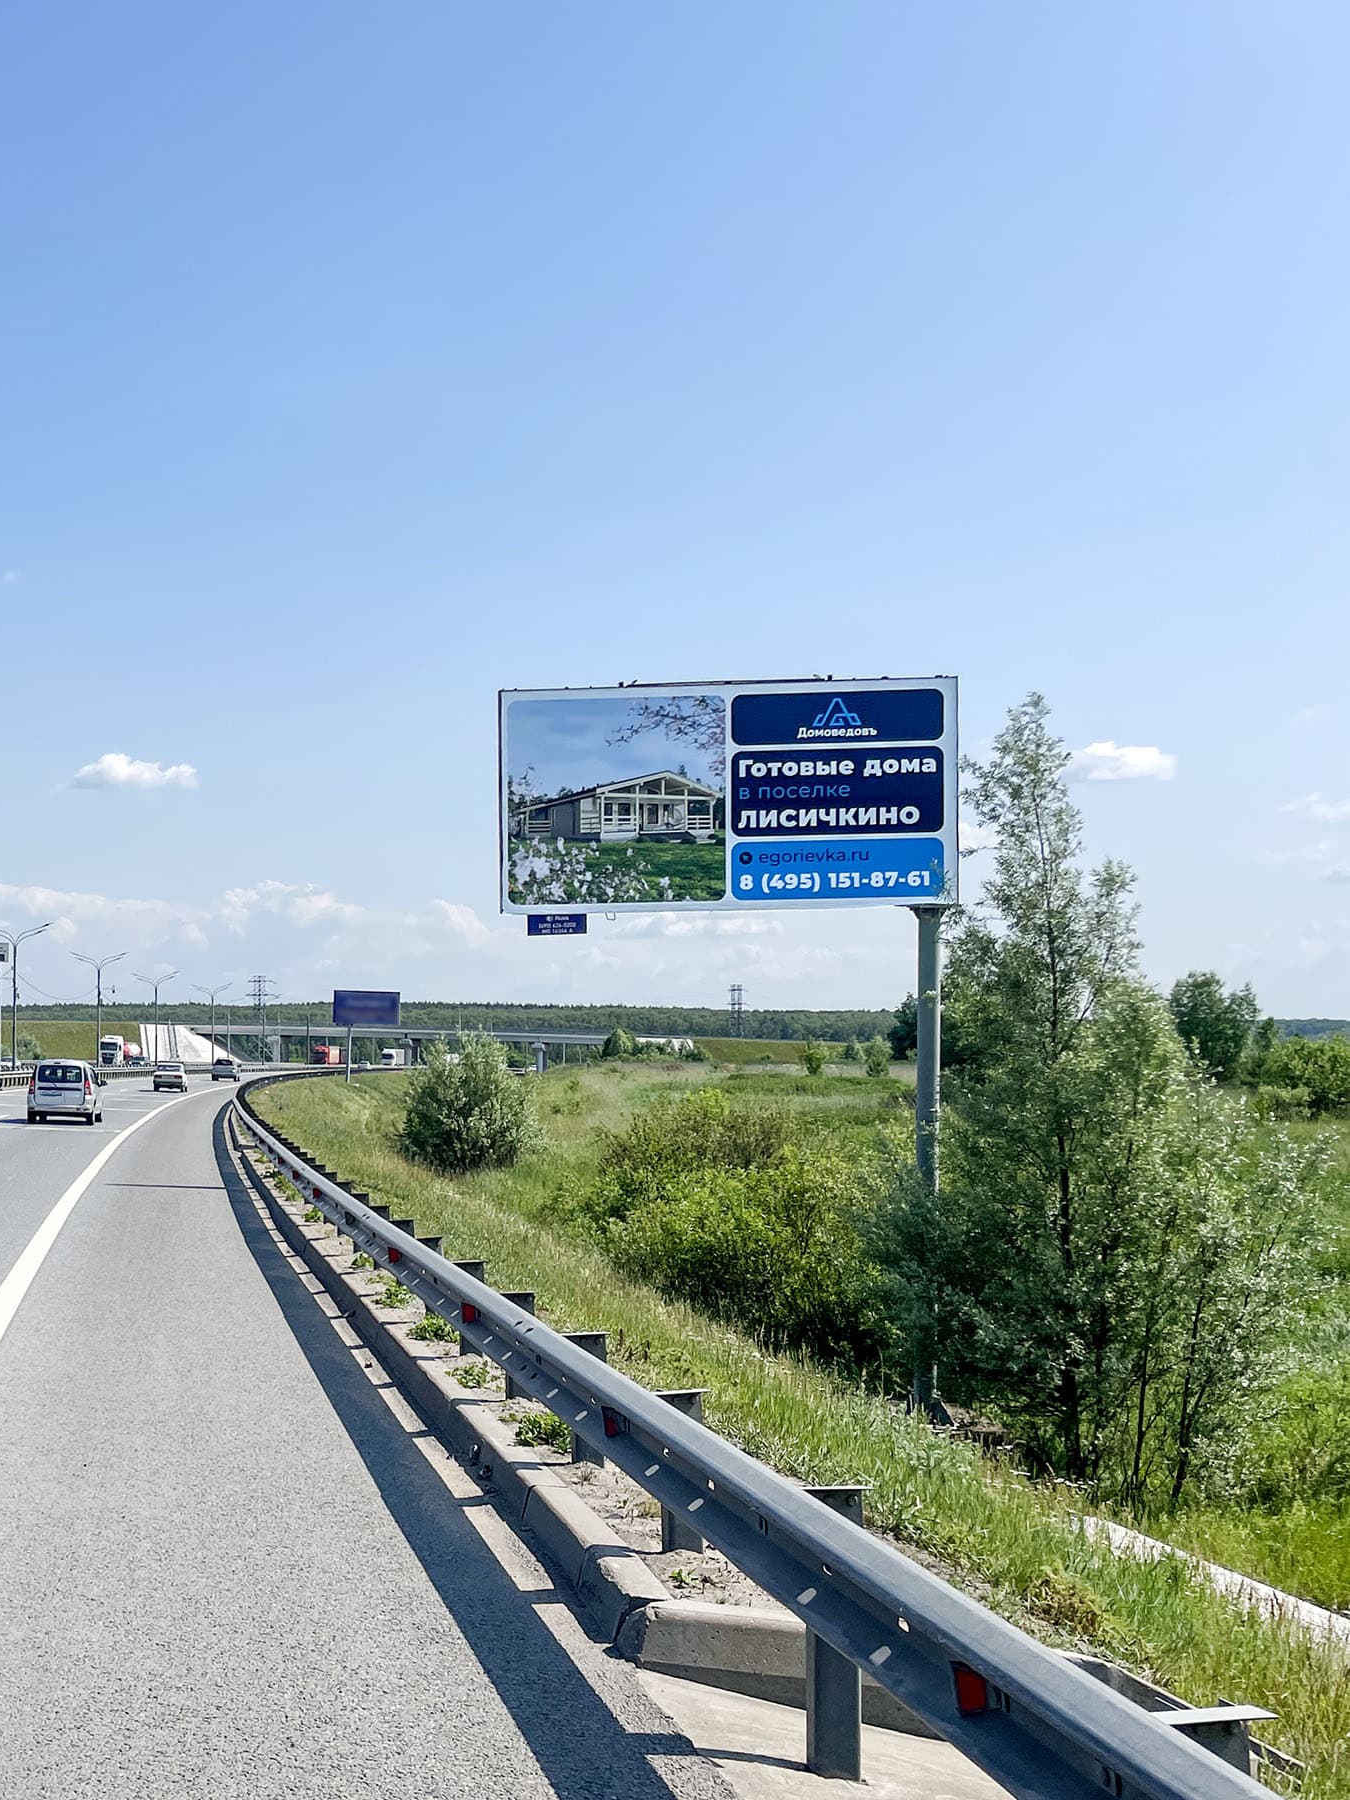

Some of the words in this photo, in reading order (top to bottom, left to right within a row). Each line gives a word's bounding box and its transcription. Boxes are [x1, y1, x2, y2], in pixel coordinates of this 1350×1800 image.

[797, 727, 877, 739] Домоведовъ
[738, 759, 855, 778] Готовые
[863, 757, 937, 777] дома
[739, 787, 750, 800] в
[758, 784, 850, 799] поселке
[737, 806, 920, 829] ЛИСИЧКИНО
[758, 848, 869, 867] egorievka.ru
[739, 874, 754, 890] 8
[761, 872, 821, 894] (495)
[828, 870, 930, 888] 151-87-61
